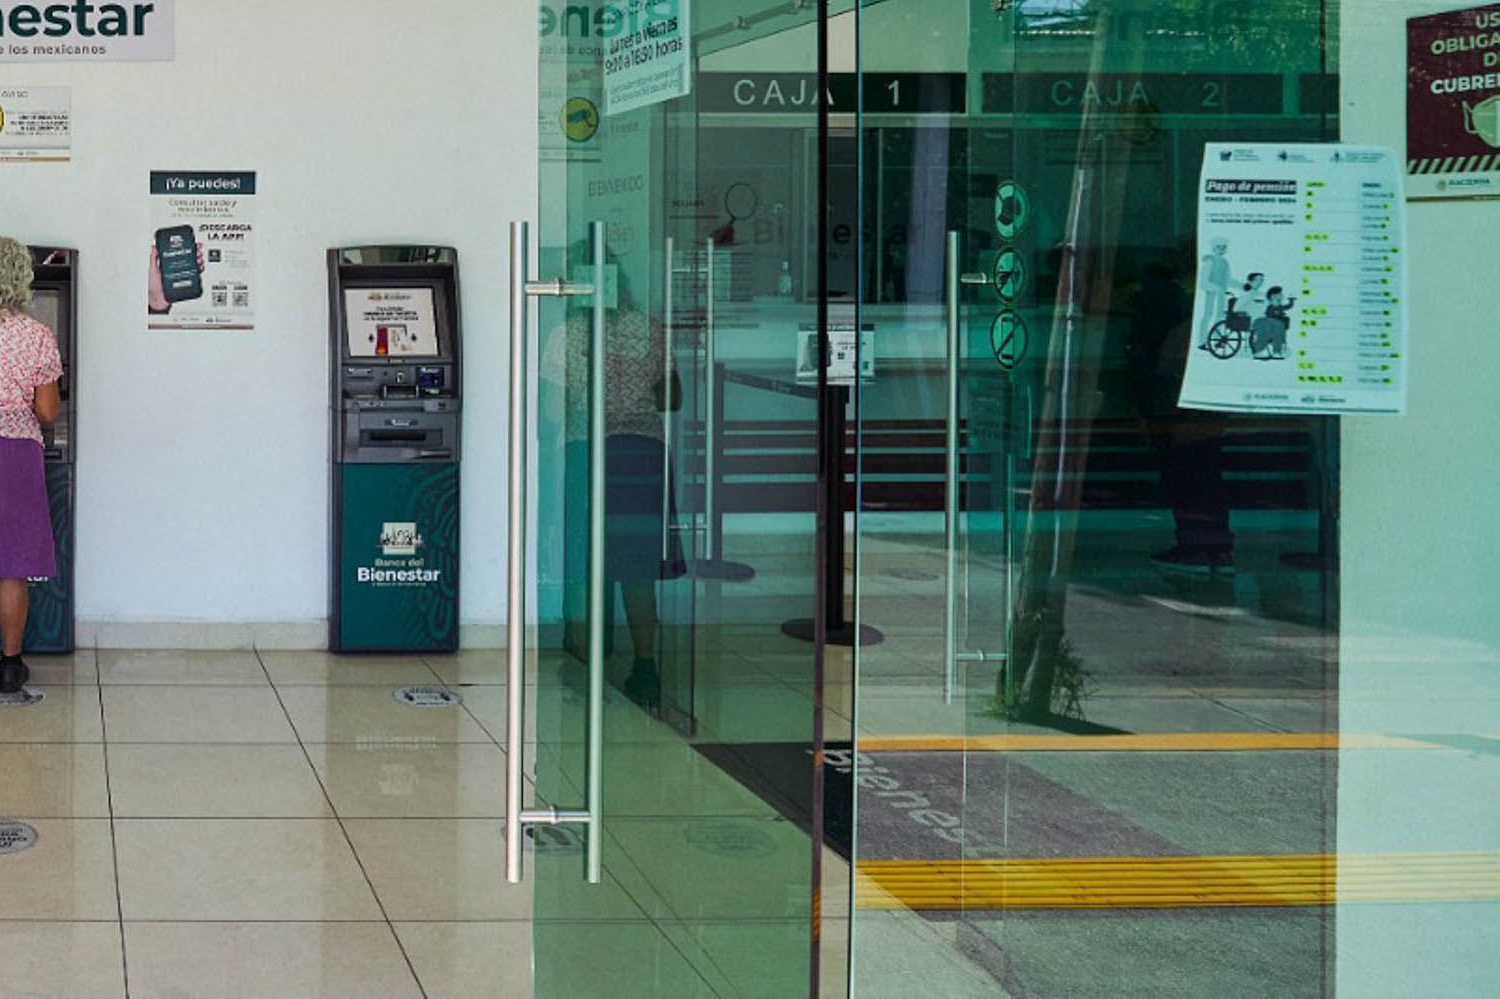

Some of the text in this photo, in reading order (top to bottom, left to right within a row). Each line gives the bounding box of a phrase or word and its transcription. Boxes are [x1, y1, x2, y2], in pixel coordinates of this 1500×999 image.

[8, 43, 29, 55] los
[33, 43, 106, 55] mexicanos
[655, 36, 683, 59] horas
[1483, 52, 1500, 67] D
[1430, 73, 1500, 94] CUBRE
[888, 80, 900, 106] 1
[1051, 80, 1219, 106] CAJA 2
[188, 177, 241, 190] puedes!
[357, 567, 441, 582] Bienestar
